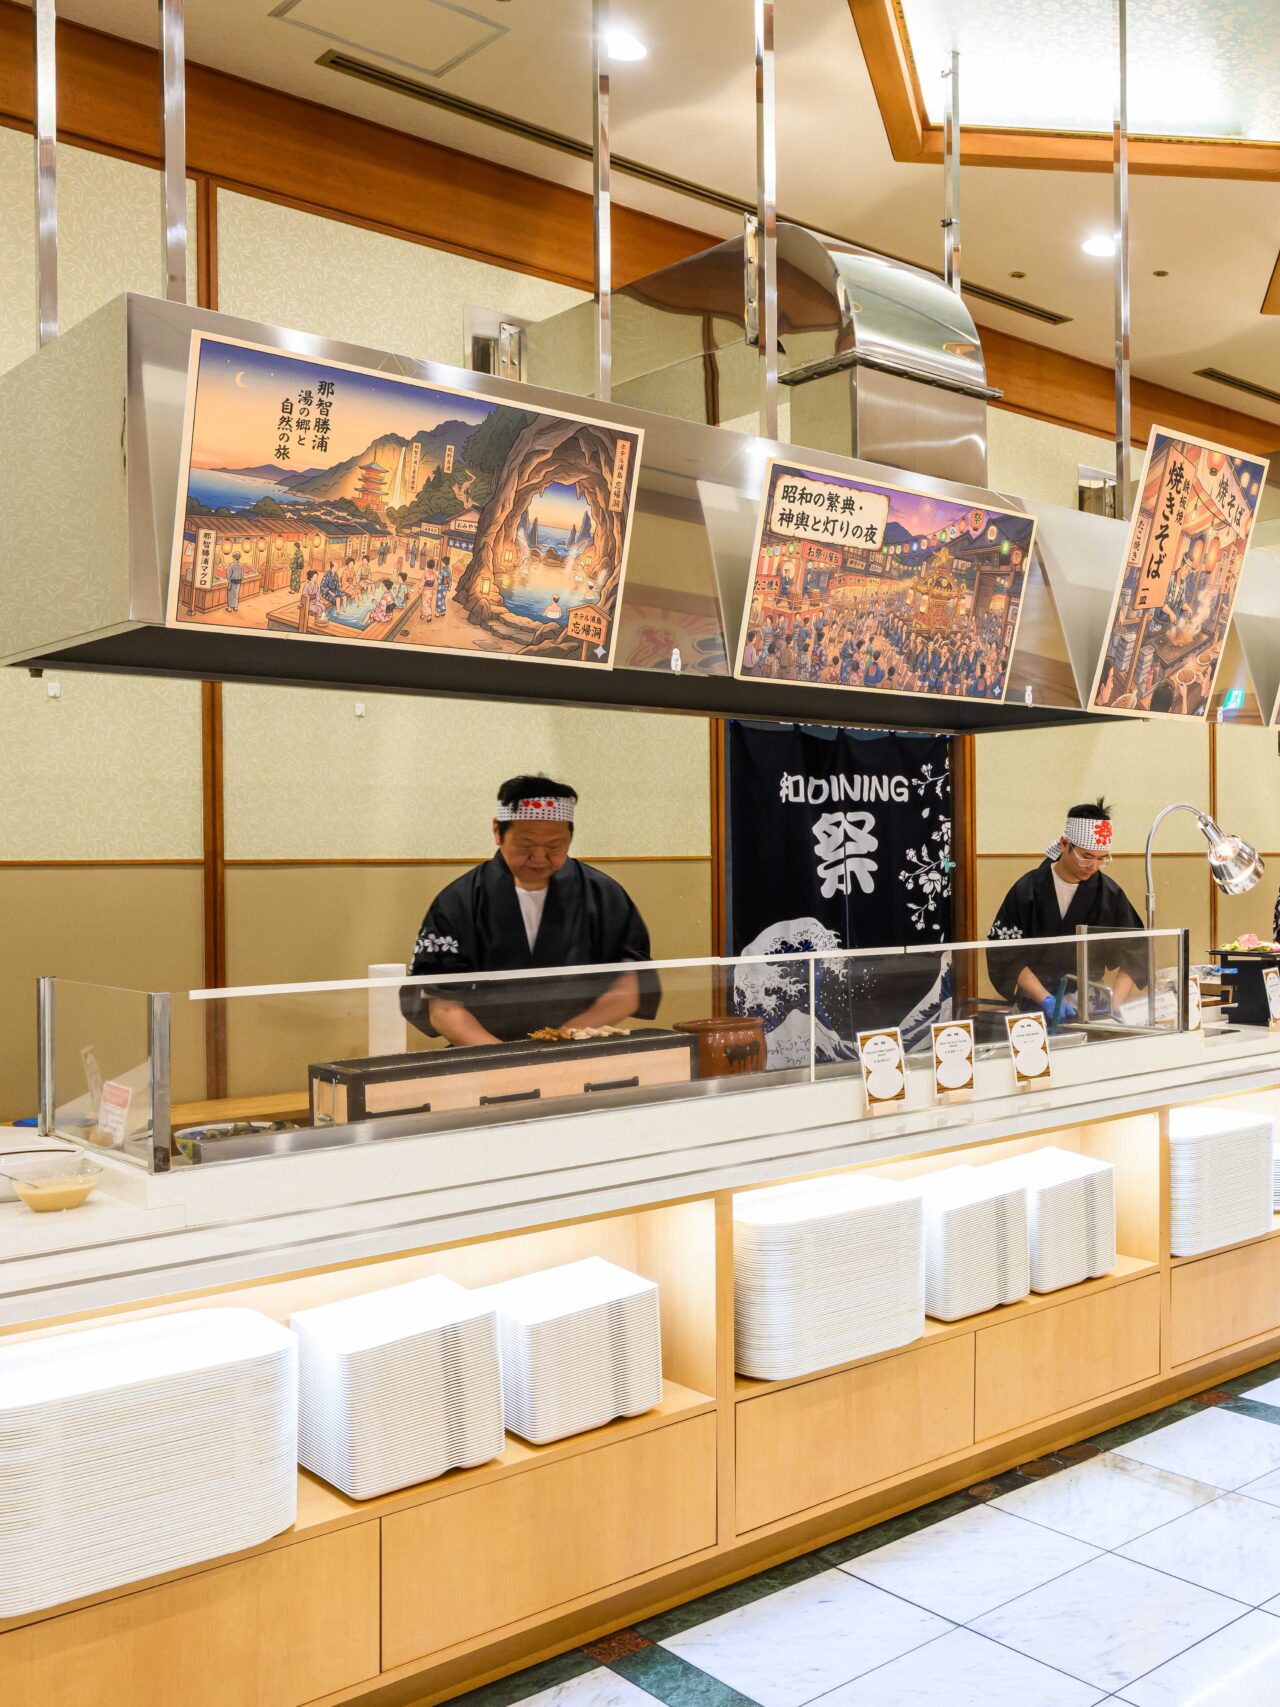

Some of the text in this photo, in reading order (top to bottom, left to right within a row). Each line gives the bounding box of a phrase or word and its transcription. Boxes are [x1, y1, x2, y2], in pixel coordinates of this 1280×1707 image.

[274, 397, 294, 460] 自然の旅
[297, 389, 314, 446] 湯の郷と
[312, 380, 335, 453] 那智勝浦
[778, 507, 878, 544] 神輿と灯りの夜
[1146, 460, 1185, 580] 焼きそば
[1216, 473, 1246, 528] 焼そば
[571, 621, 602, 639] 忘帰洞
[811, 811, 879, 899] 祭
